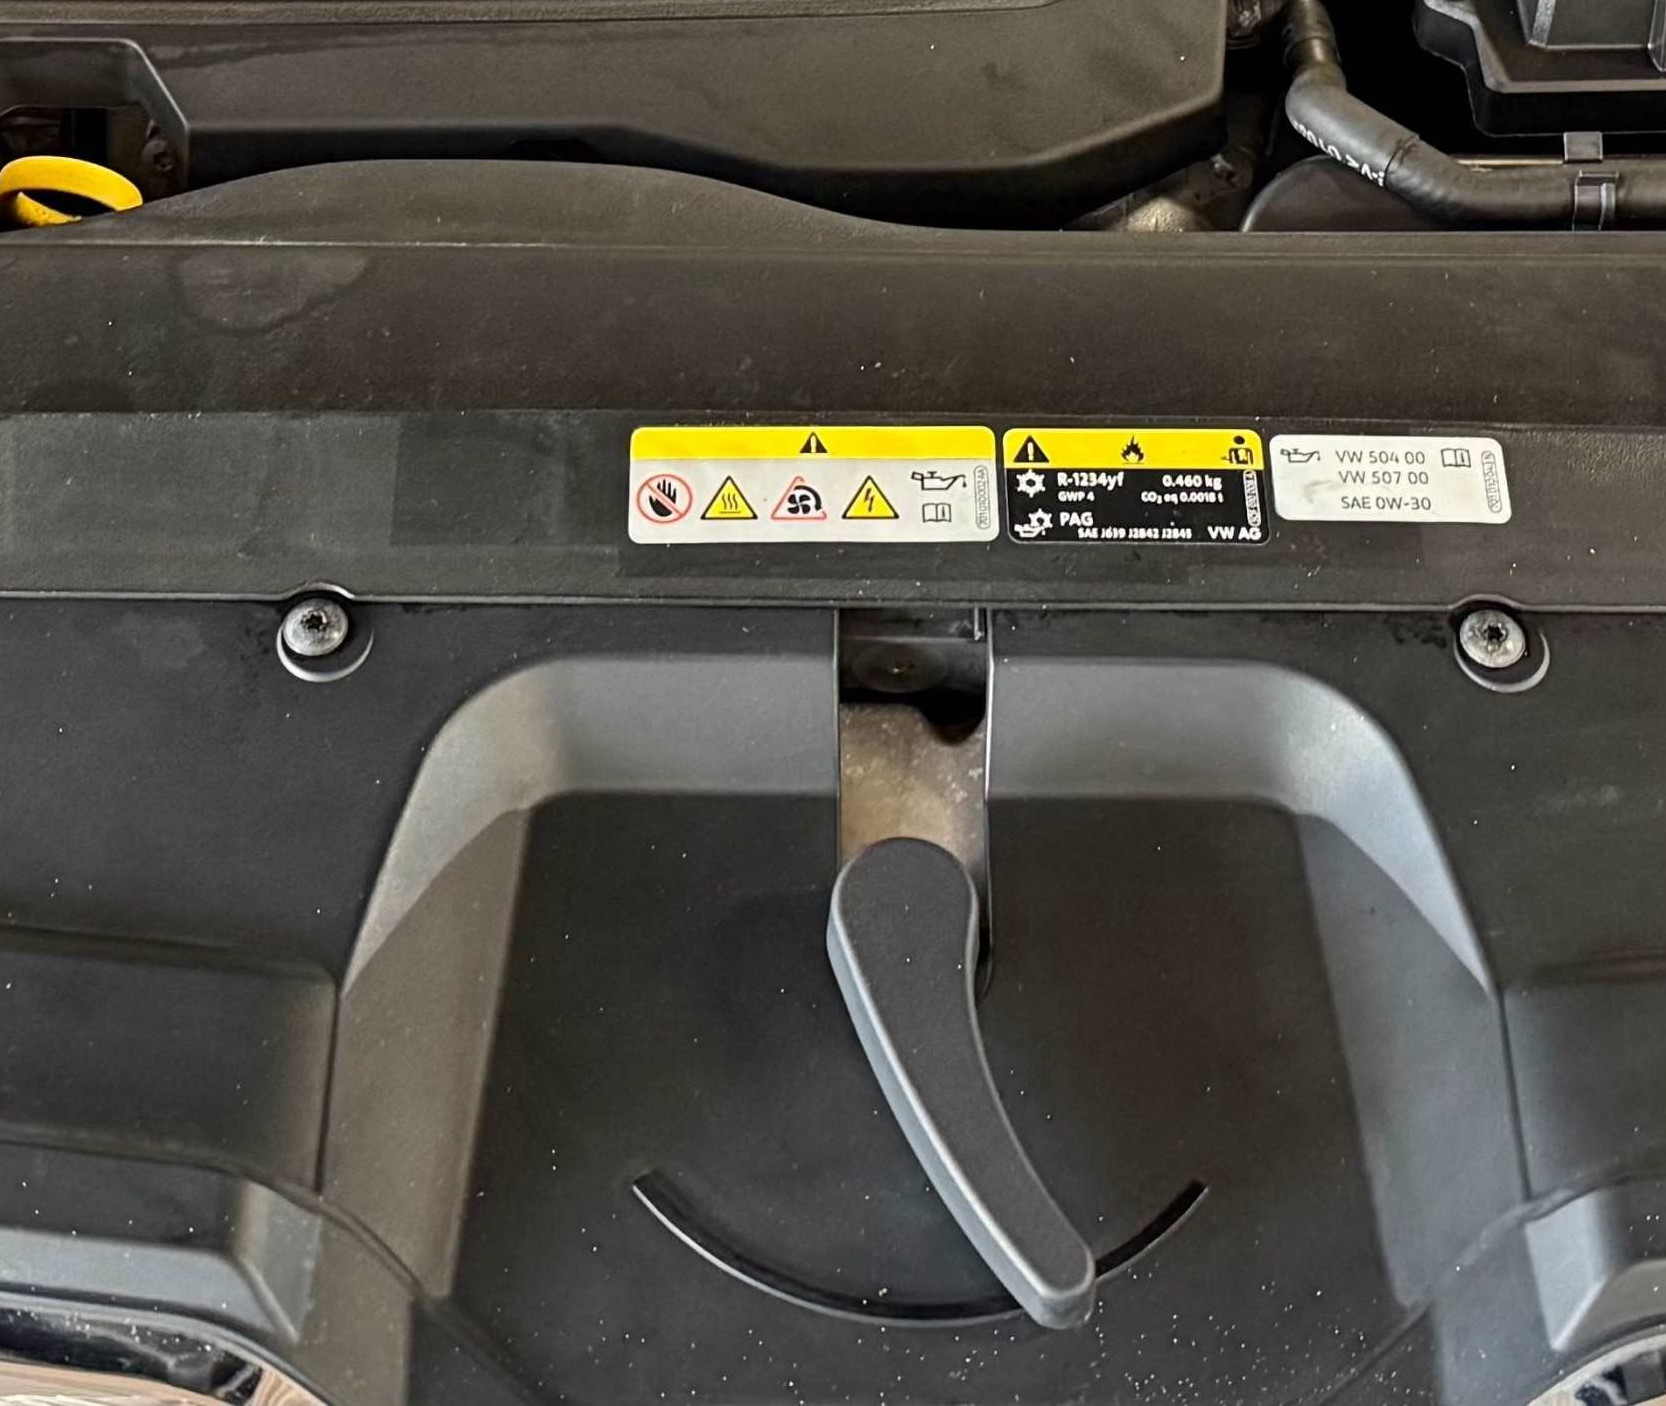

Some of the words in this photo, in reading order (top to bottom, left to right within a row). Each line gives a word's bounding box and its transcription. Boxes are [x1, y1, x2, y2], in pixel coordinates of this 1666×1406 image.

[1335, 450, 1363, 464] VW
[1368, 450, 1399, 464] 504
[1404, 451, 1426, 465] 00
[1056, 472, 1125, 490] R-1234yf
[1162, 474, 1202, 489] 0.460
[1204, 474, 1222, 491] kg
[1338, 471, 1366, 484] VW
[1371, 471, 1403, 484] 507
[1408, 471, 1429, 485] 00
[1058, 491, 1085, 502] GWP
[1086, 492, 1095, 502] 4
[1164, 493, 1179, 505] eq
[1217, 492, 1224, 503] t
[1341, 496, 1372, 510] SAE
[1376, 497, 1432, 511] 0W-30
[1059, 512, 1094, 527] PAG
[1078, 528, 1099, 539] SAE
[1207, 526, 1235, 541] VW
[1238, 527, 1263, 541] AG
